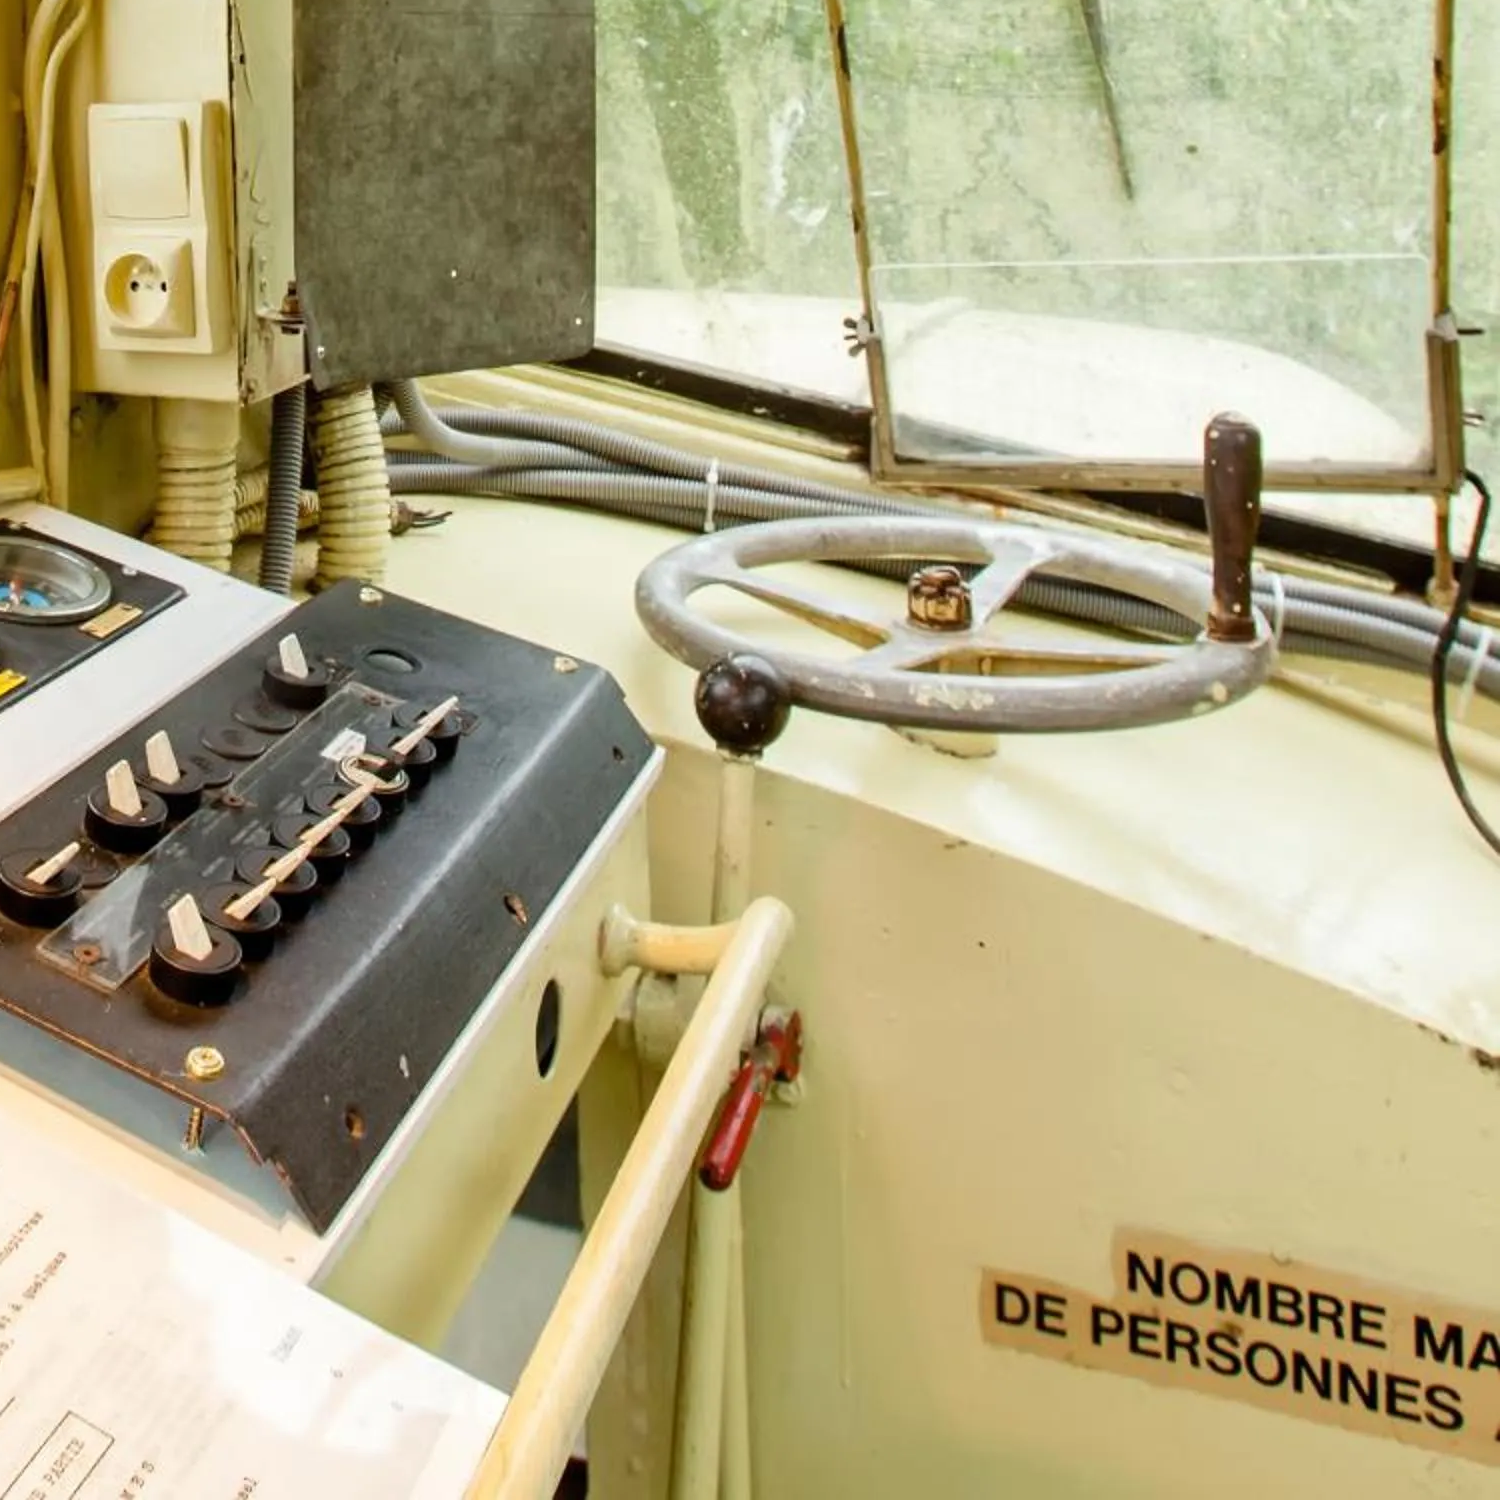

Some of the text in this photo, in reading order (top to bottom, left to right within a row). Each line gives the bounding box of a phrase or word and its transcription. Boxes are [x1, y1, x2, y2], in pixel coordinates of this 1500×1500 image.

[995, 1282, 1464, 1433] DE PERSONNES
[1126, 1250, 1388, 1350] NOMBRE
